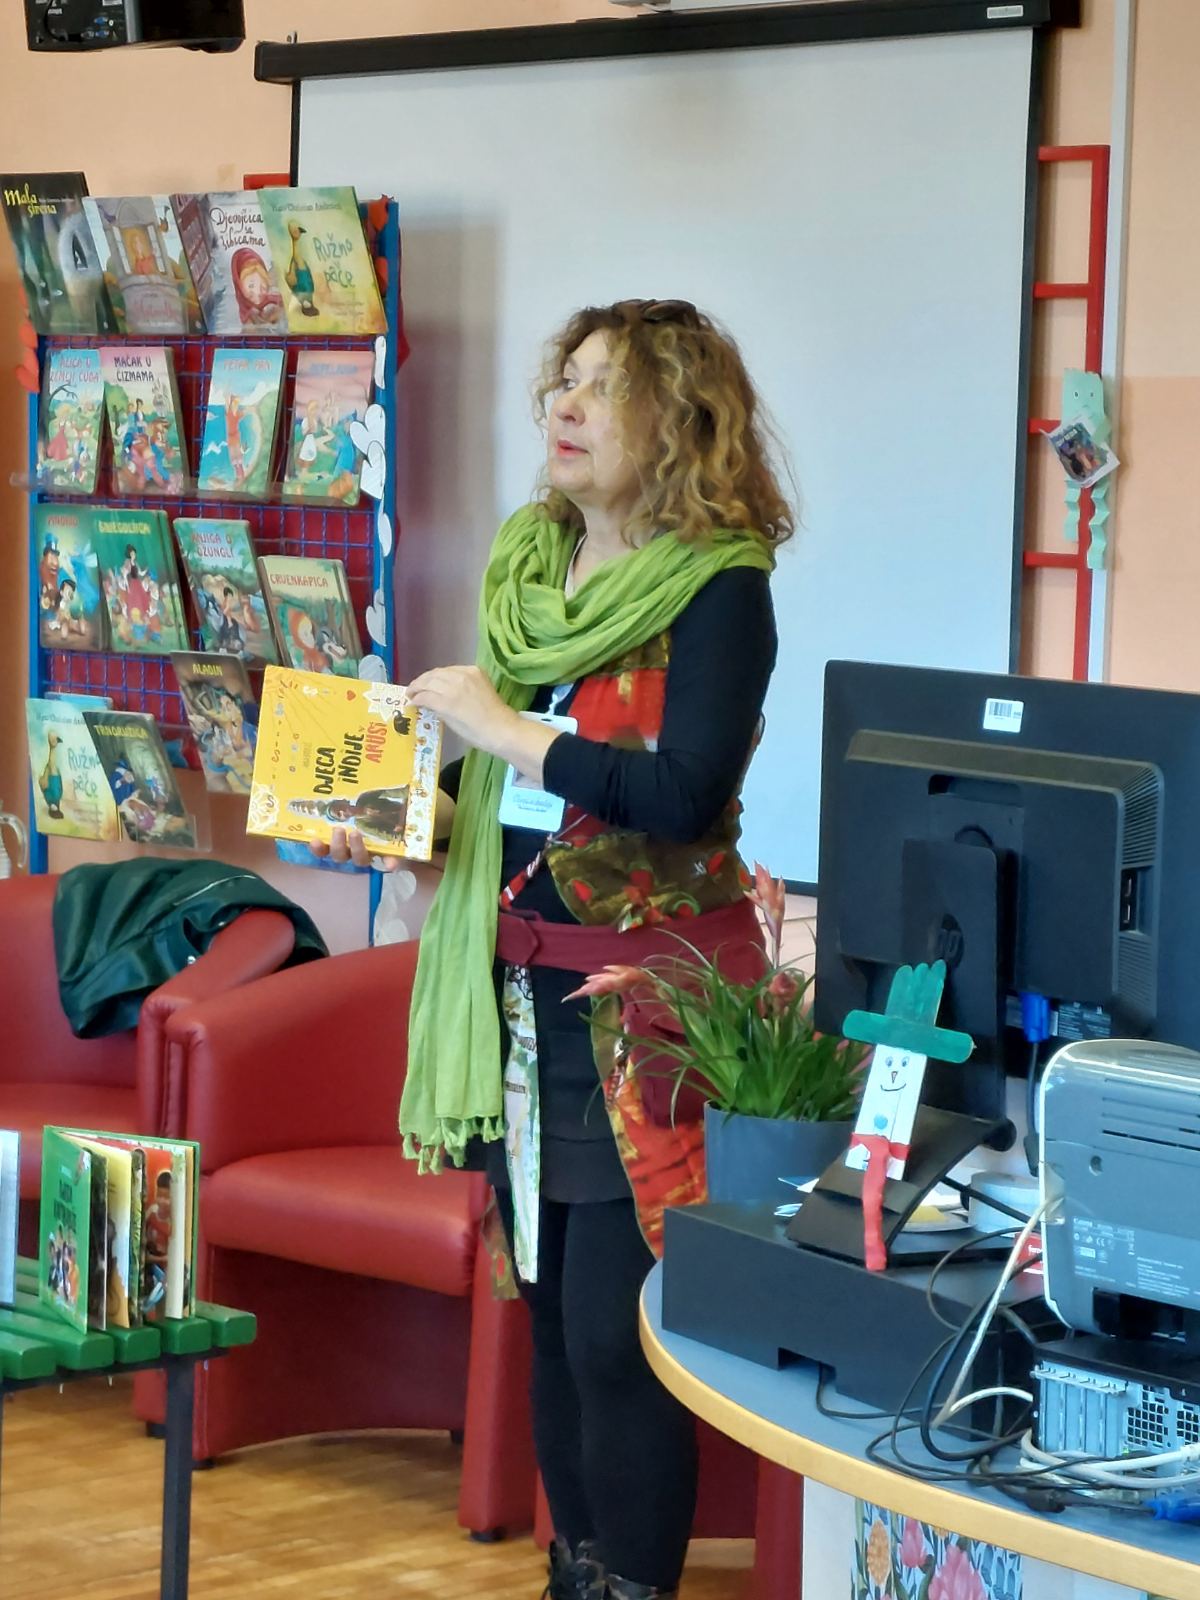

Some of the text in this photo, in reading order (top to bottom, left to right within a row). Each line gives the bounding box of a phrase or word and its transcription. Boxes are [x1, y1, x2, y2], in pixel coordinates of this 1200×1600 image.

[4, 183, 38, 206] Mala
[145, 357, 152, 368] U
[312, 746, 337, 796] DJECA
